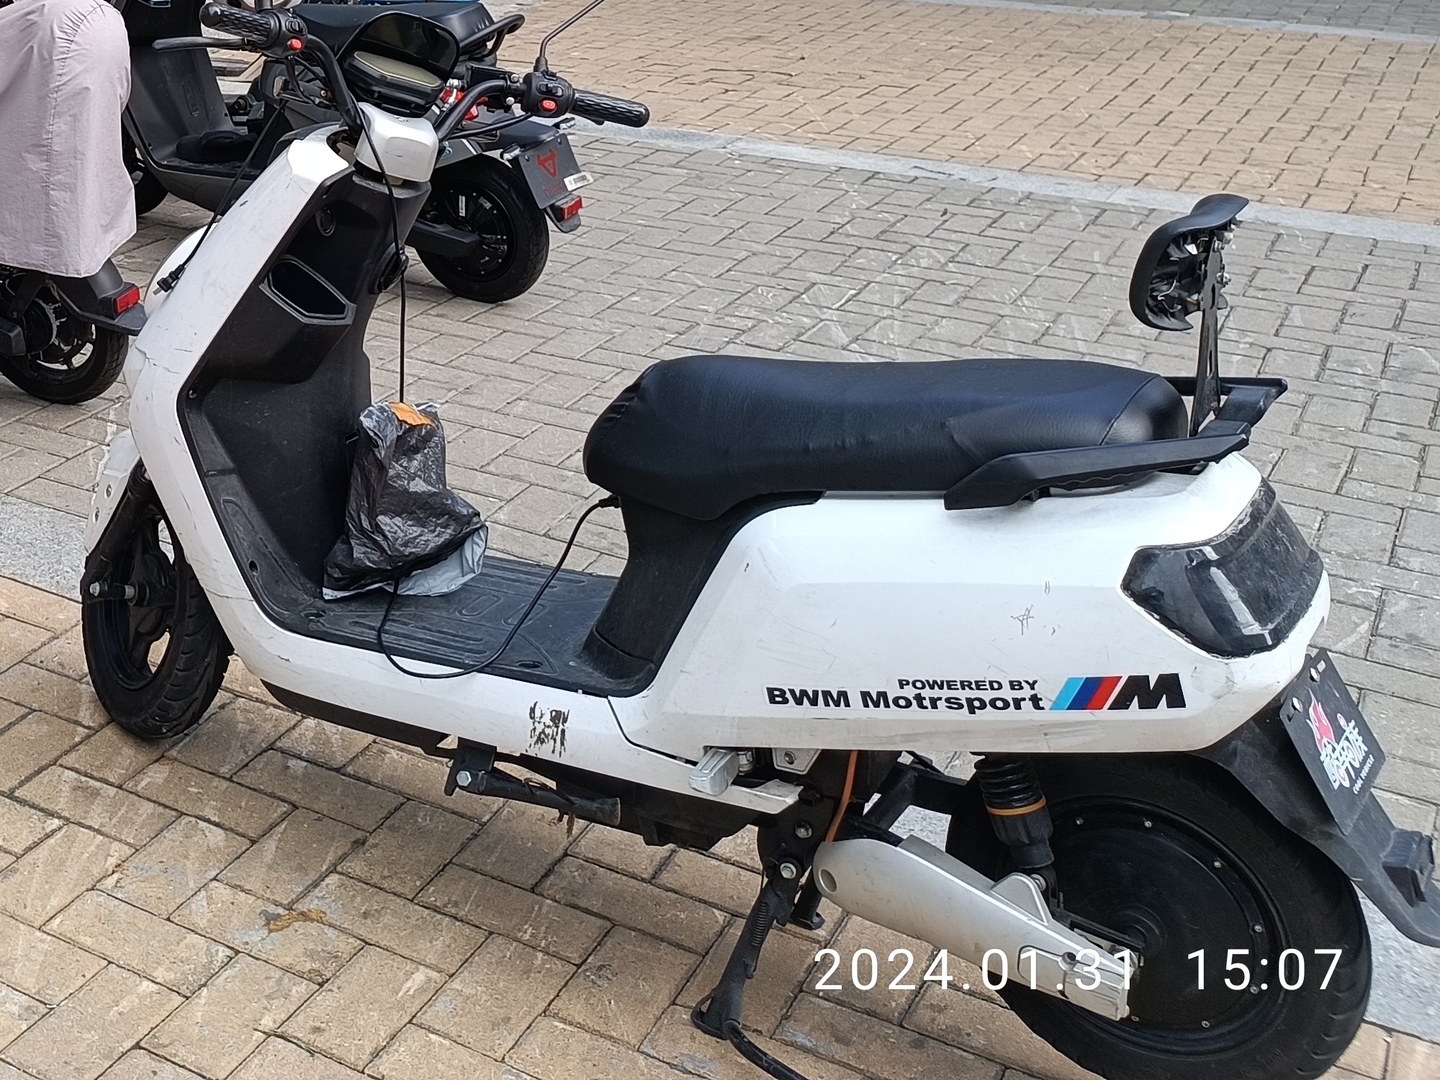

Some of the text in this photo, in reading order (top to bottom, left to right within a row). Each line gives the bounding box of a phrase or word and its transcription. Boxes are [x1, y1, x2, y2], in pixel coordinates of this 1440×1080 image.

[898, 678, 1038, 692] POWERED BY
[765, 686, 1046, 716] BWM Motrsport
